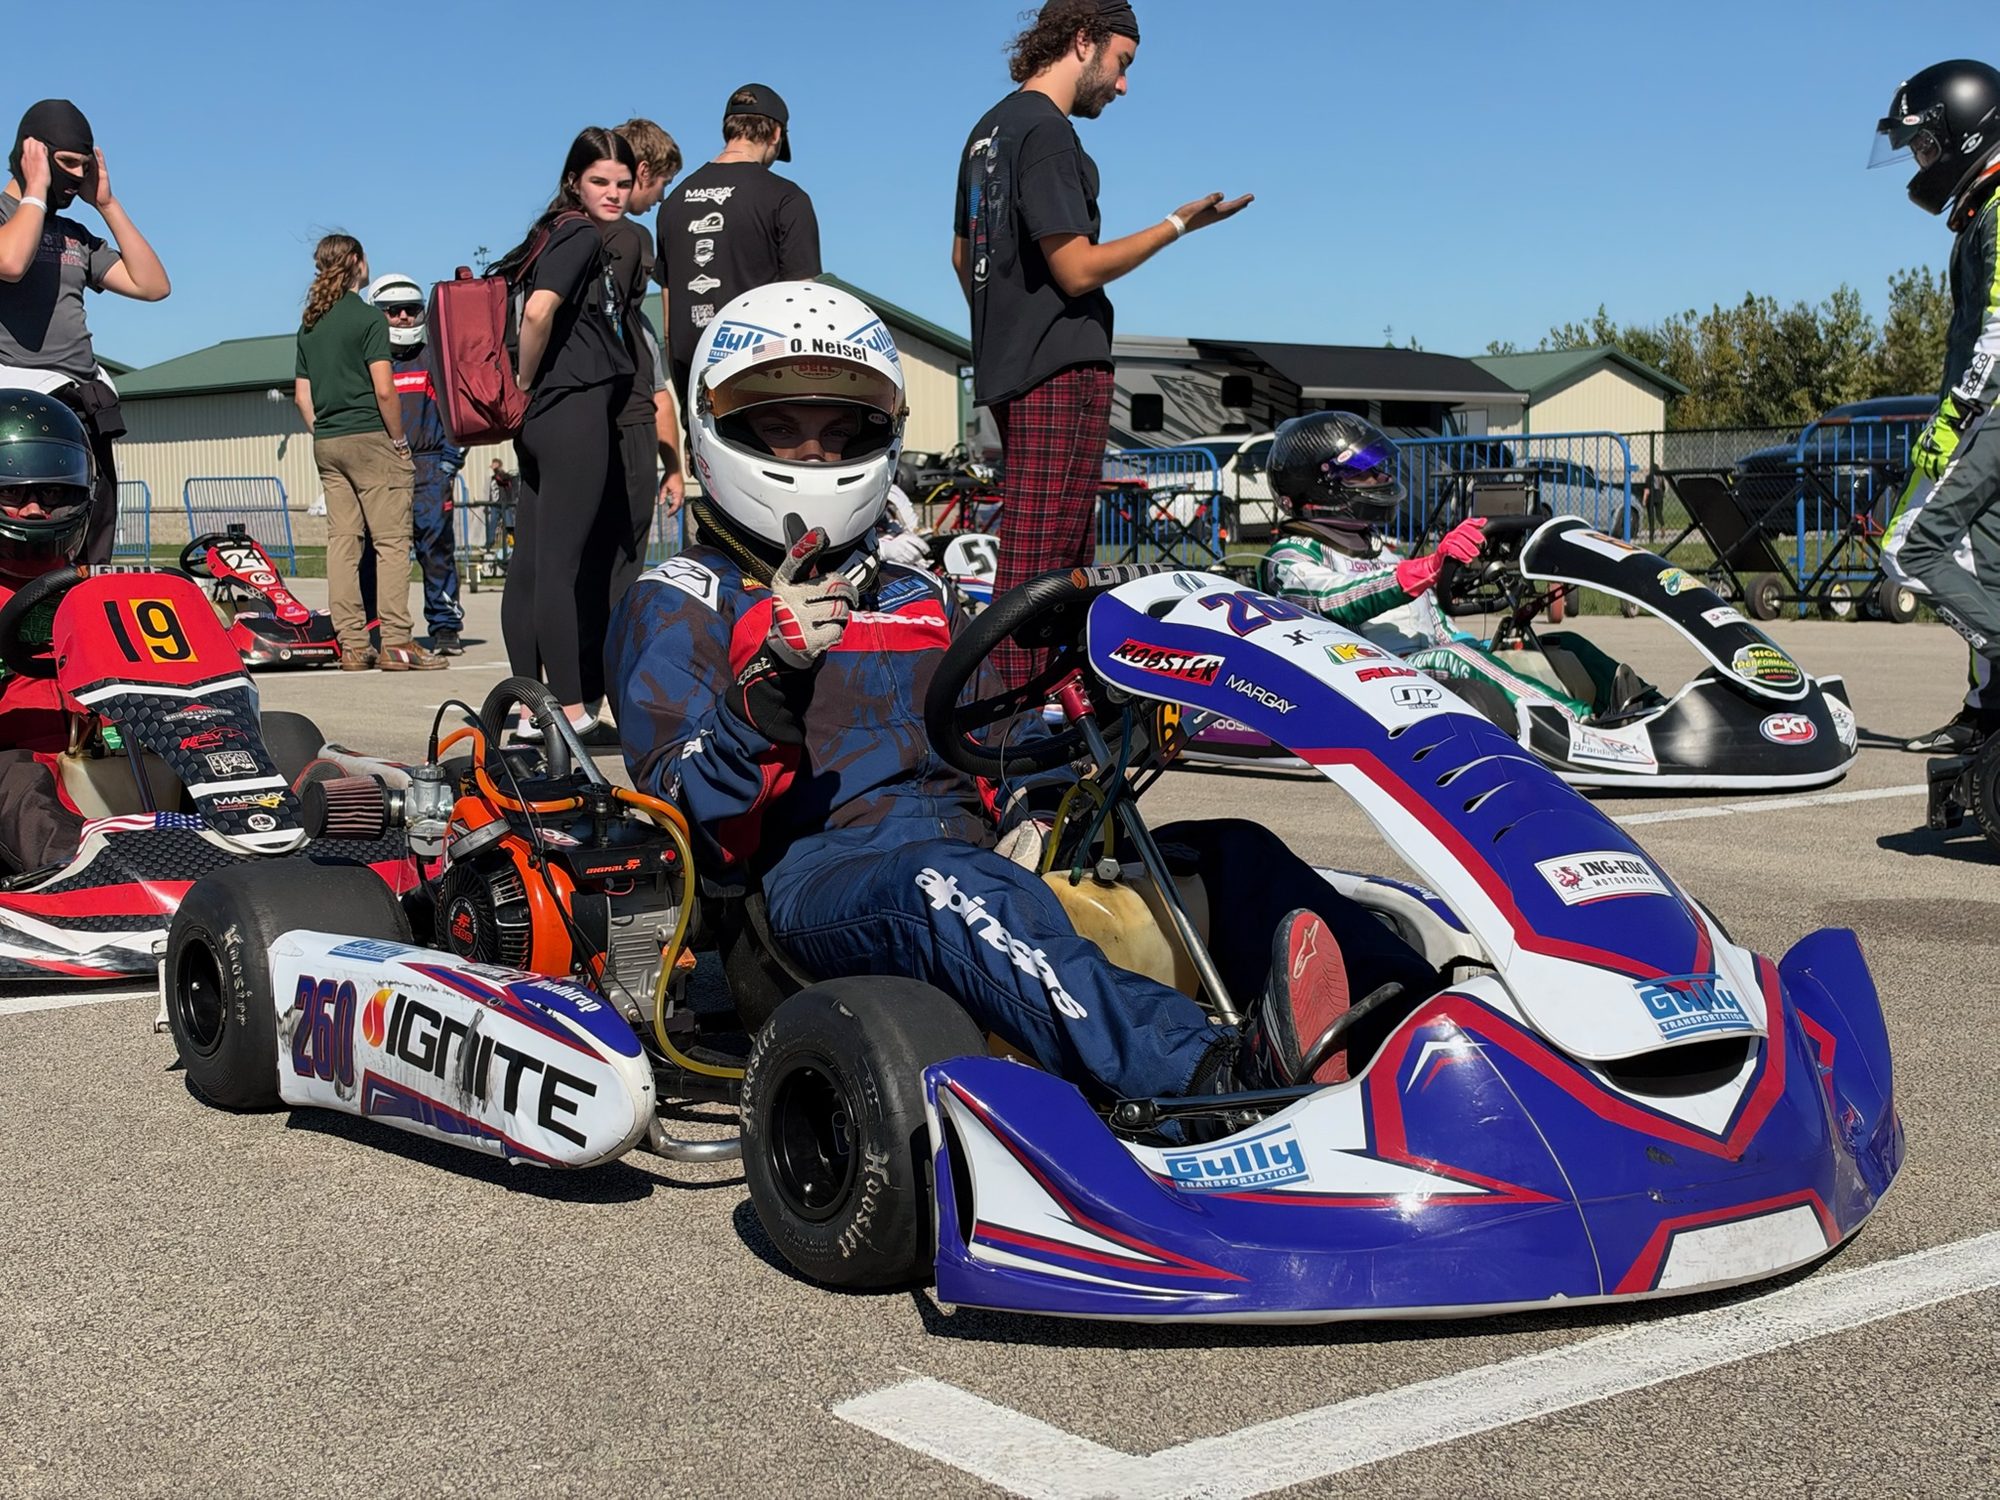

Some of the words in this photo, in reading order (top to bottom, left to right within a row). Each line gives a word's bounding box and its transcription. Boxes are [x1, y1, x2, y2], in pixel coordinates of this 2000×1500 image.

[713, 327, 764, 351] Gull
[790, 338, 807, 353] O.
[812, 338, 868, 362] Neisel
[224, 549, 263, 571] 24
[1197, 590, 1315, 637] 26
[104, 600, 191, 662] 19
[1225, 674, 1298, 715] MARGAY
[1767, 717, 1809, 735] CKT
[212, 791, 286, 806] MARGAY
[1580, 860, 1649, 876] ING-KUO
[915, 867, 1088, 1019] alpinestars
[1640, 981, 1750, 1021] Gully
[292, 974, 358, 1088] 260
[1661, 1013, 1745, 1030] TRANSPORTATION
[386, 993, 598, 1149] IGNITE
[1165, 1139, 1306, 1180] Gully
[1178, 1167, 1298, 1188] TRANSPORTATION
